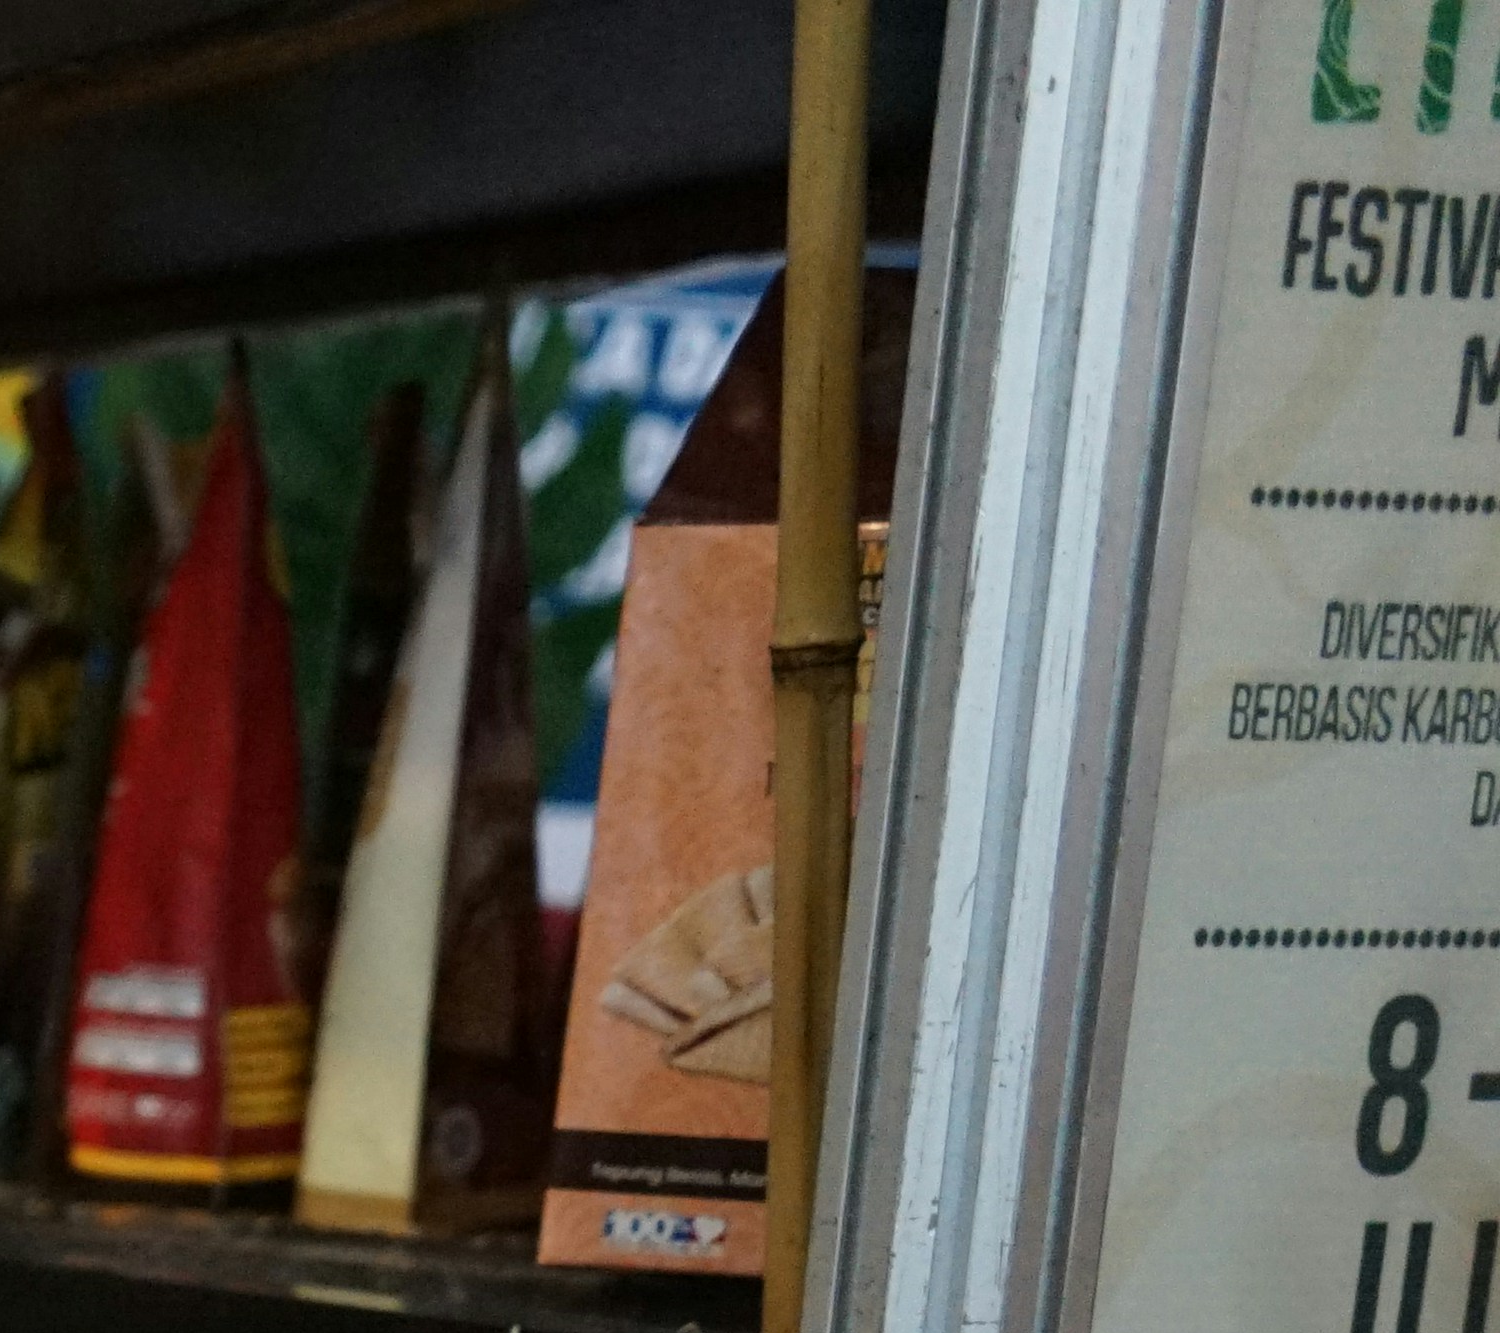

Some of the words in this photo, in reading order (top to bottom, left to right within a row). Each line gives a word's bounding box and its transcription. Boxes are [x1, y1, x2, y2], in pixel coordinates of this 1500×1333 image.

[1311, 0, 1500, 135] LI
[1228, 682, 1394, 743] BERBASIS
[1403, 686, 1500, 745] KARB
[1470, 769, 1500, 827] D
[1356, 993, 1441, 1177] 8
